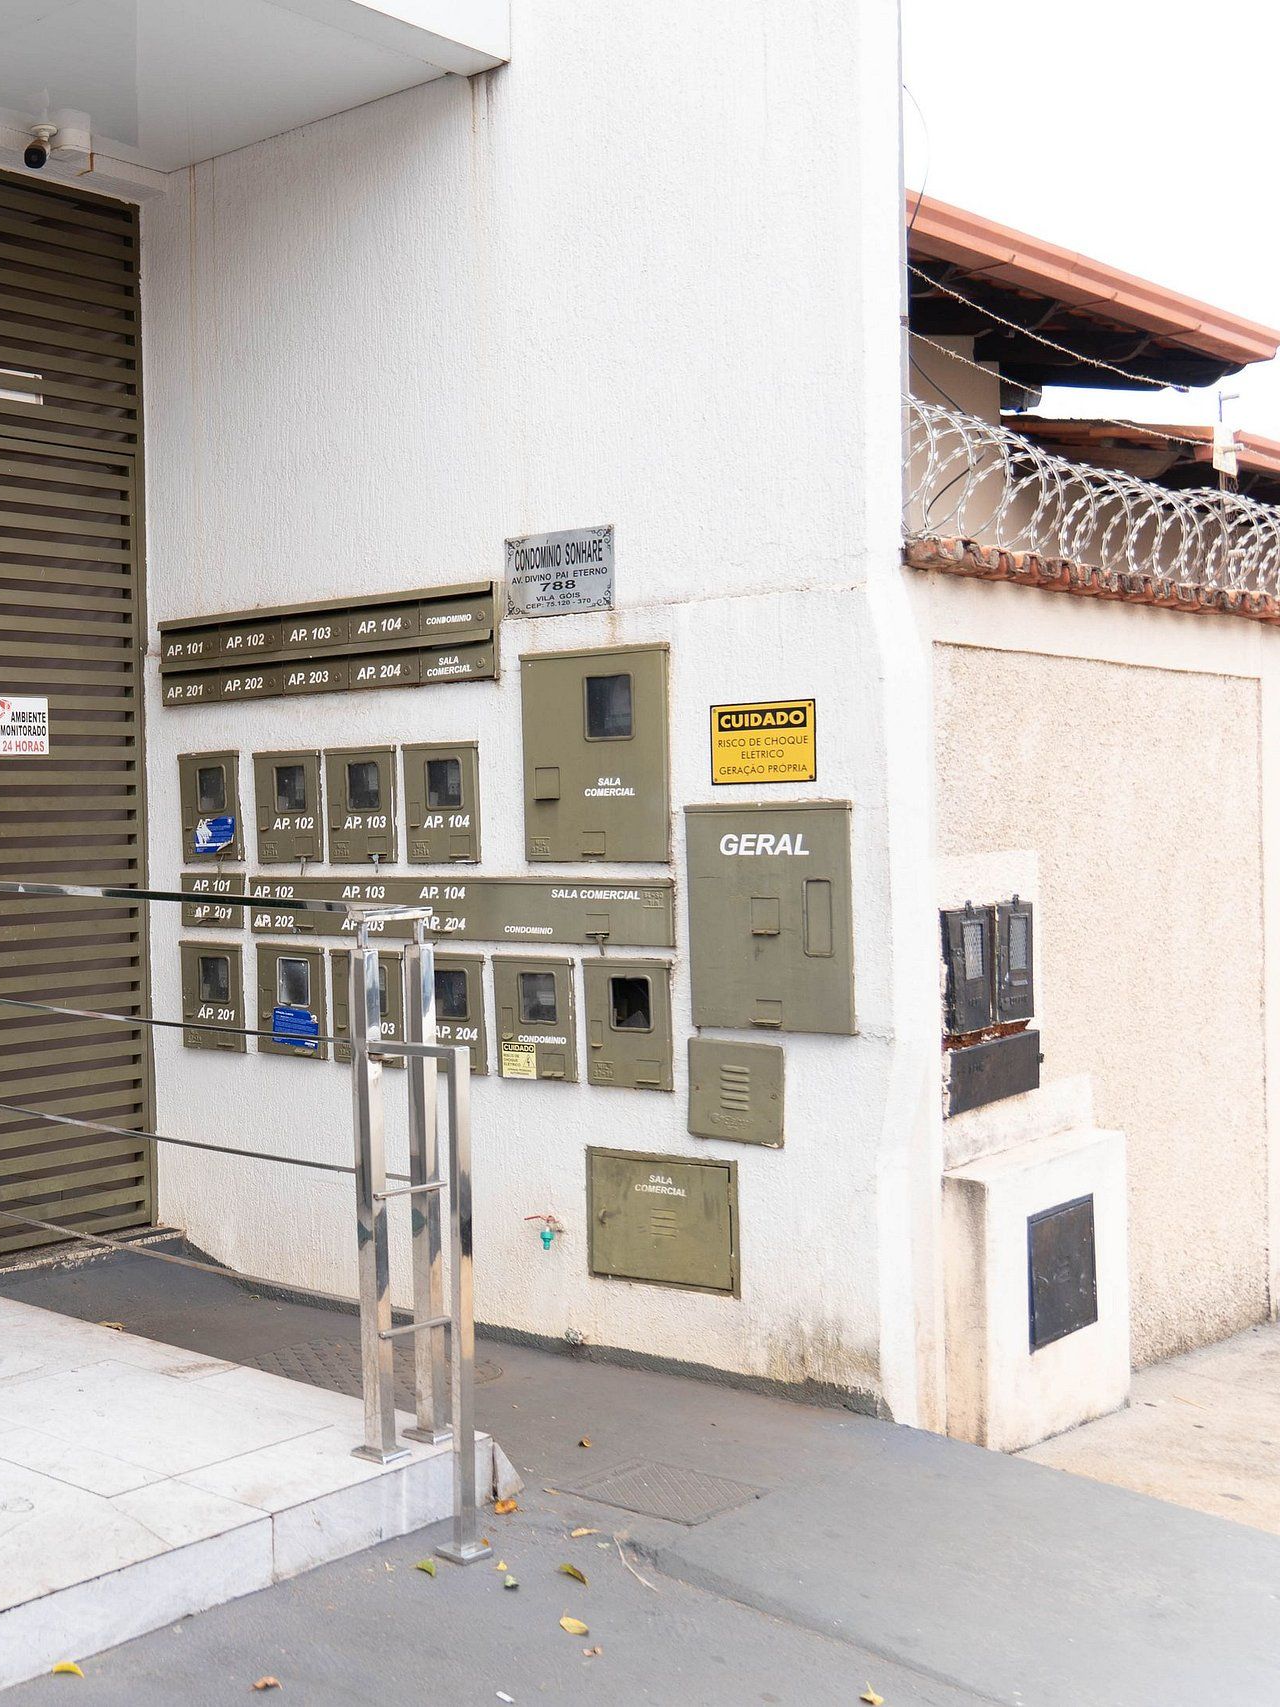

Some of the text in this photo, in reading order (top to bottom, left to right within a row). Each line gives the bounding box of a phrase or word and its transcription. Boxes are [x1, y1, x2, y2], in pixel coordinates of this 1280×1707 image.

[565, 539, 603, 566] SONHARE
[511, 566, 608, 585] AV. DIVINO PAI ETERNO
[540, 579, 576, 592] 788
[536, 594, 555, 602] VILA
[525, 602, 544, 610] CEP:
[357, 617, 402, 634] AP. 104
[426, 613, 472, 625] CONDOMINIO
[289, 626, 331, 642] AP. 103
[226, 633, 265, 649] AP. 102
[167, 642, 203, 657] AP. 101
[438, 655, 459, 665] SALA
[356, 664, 401, 680] AP. 204
[426, 664, 472, 677] COMERCIAL
[288, 670, 329, 685] AP. 203
[224, 677, 263, 692] AP. 202
[167, 684, 203, 699] AP. 201
[11, 711, 46, 723] AMBIENTE
[720, 710, 805, 729] CUIDADO
[0, 725, 47, 737] MONITORADO
[2, 740, 45, 752] 24 HORAS
[718, 735, 809, 748] RISCO DE CHOQUE
[719, 763, 765, 776] GERAÇÃO
[598, 777, 621, 786] SALA
[584, 787, 636, 797] COMERCIAL
[273, 816, 314, 830] AP. 102
[344, 815, 387, 830] AP. 103
[424, 814, 470, 829] AP. 104
[720, 833, 810, 856] GERAL
[193, 879, 231, 892] AP. 101
[254, 886, 294, 898] AP. 102
[341, 885, 385, 899] AP. 103
[419, 886, 466, 899] AP. 104
[551, 889, 577, 899] SALA
[580, 889, 641, 900] COMERCIAL
[214, 906, 232, 919] 201
[274, 915, 294, 928] 202
[444, 917, 466, 930] 204
[504, 925, 553, 935] CONDOMINIO
[218, 1008, 236, 1021] 201
[381, 1022, 396, 1035] 03
[456, 1027, 478, 1041] 204
[518, 1034, 567, 1045] CONDOMINIO
[503, 1045, 535, 1053] CUIDADO
[649, 1174, 673, 1185] SALA
[634, 1183, 687, 1197] COMERCIAL
